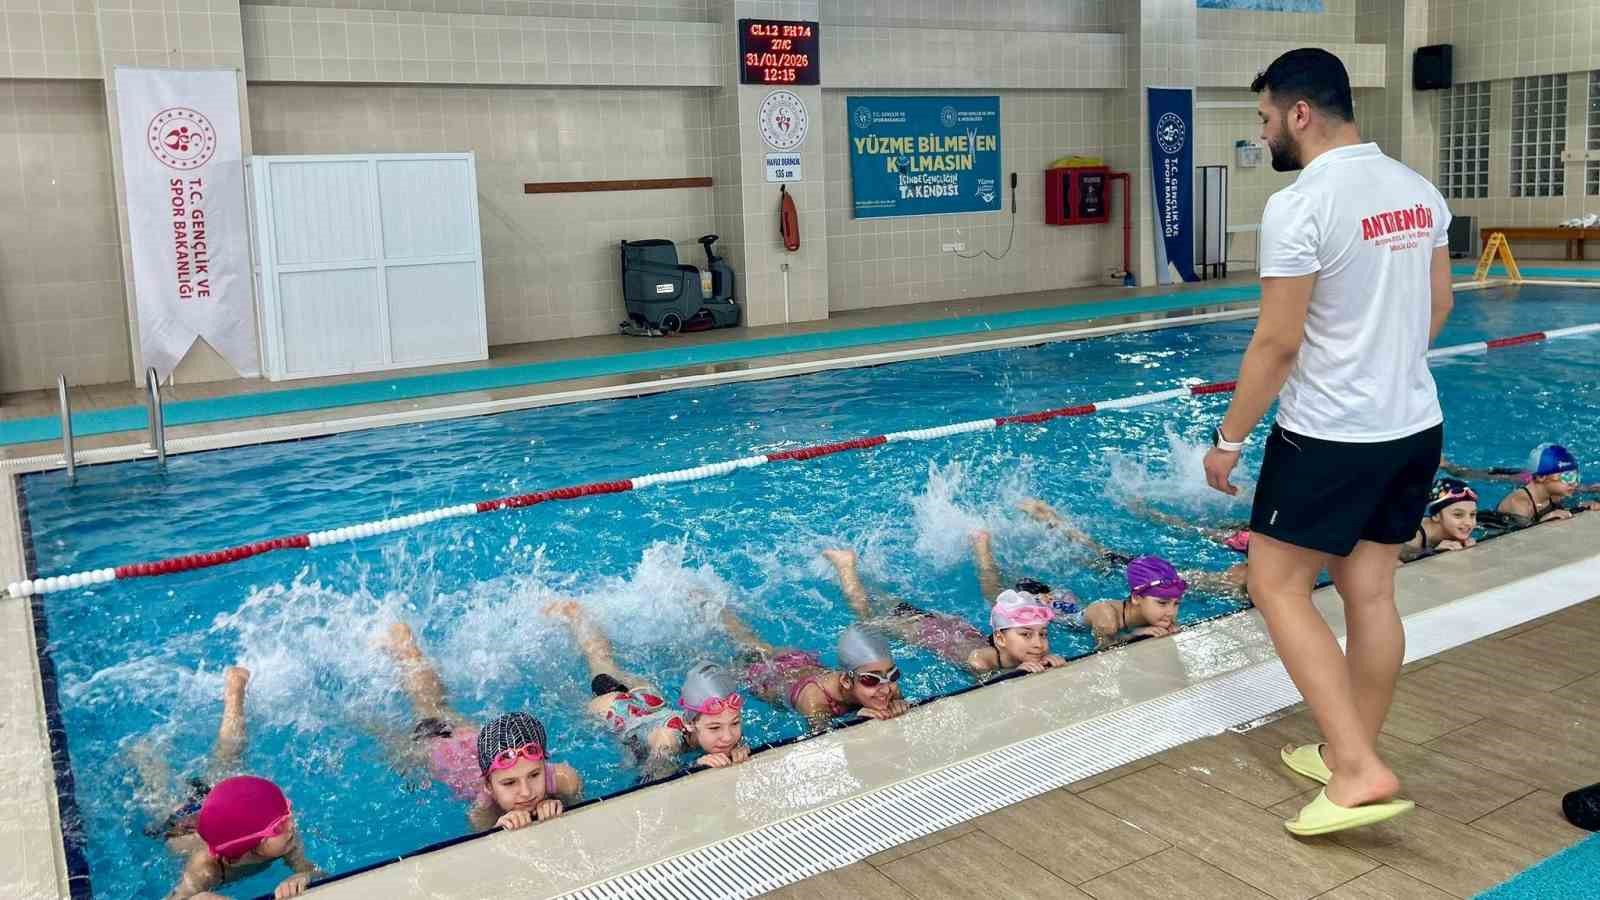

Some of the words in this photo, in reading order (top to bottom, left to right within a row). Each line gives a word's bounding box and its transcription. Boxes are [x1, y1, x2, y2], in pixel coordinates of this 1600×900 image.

[746, 53, 809, 67] 31/01/2026
[764, 69, 796, 81] 12:15
[854, 133, 915, 154] YÜZME
[170, 179, 185, 217] SPOR
[189, 178, 203, 205] T.C.
[190, 209, 210, 274] GENÇLİK
[174, 221, 194, 299] BAKANLIĞI
[197, 279, 210, 298] VE
